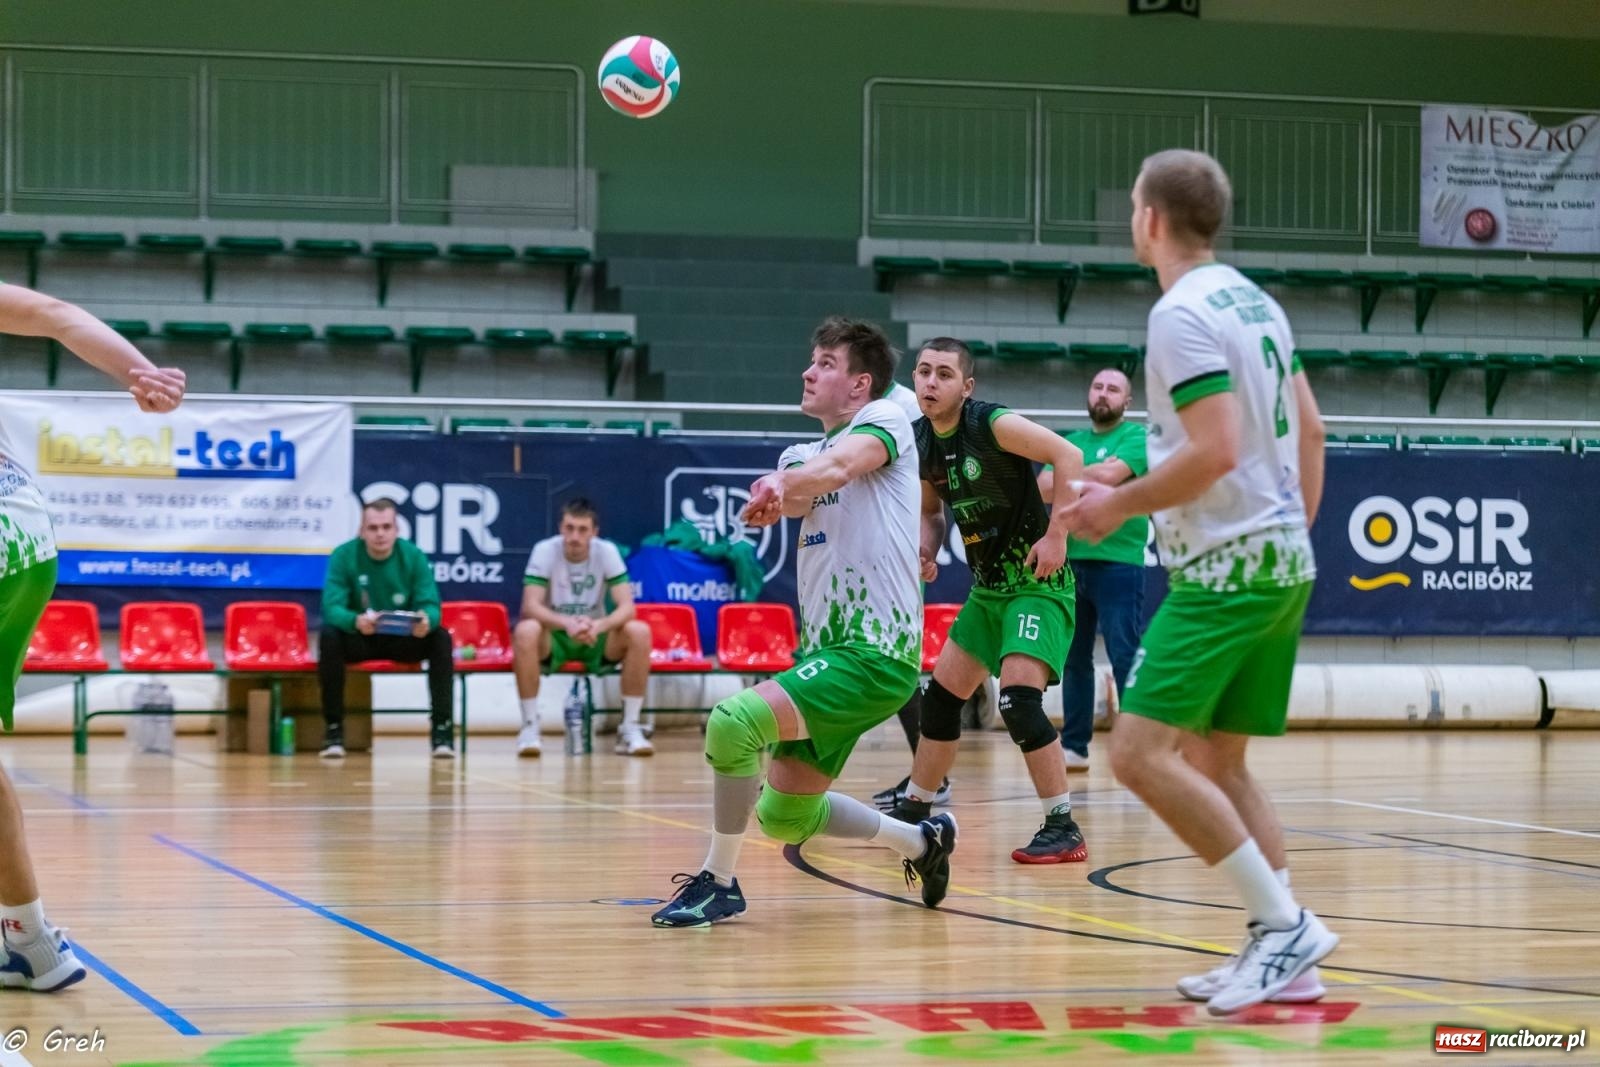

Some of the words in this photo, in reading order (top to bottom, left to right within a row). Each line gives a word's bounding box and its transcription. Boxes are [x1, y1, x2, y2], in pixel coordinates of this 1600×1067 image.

[1446, 114, 1587, 153] MIESZKO
[1260, 335, 1289, 440] 2
[38, 420, 296, 475] instal-tech
[350, 481, 503, 556] SiR
[1348, 495, 1533, 566] OSiR
[1422, 566, 1533, 591] RACIBÓRZ
[1016, 612, 1042, 642] 15
[796, 658, 829, 682] 6
